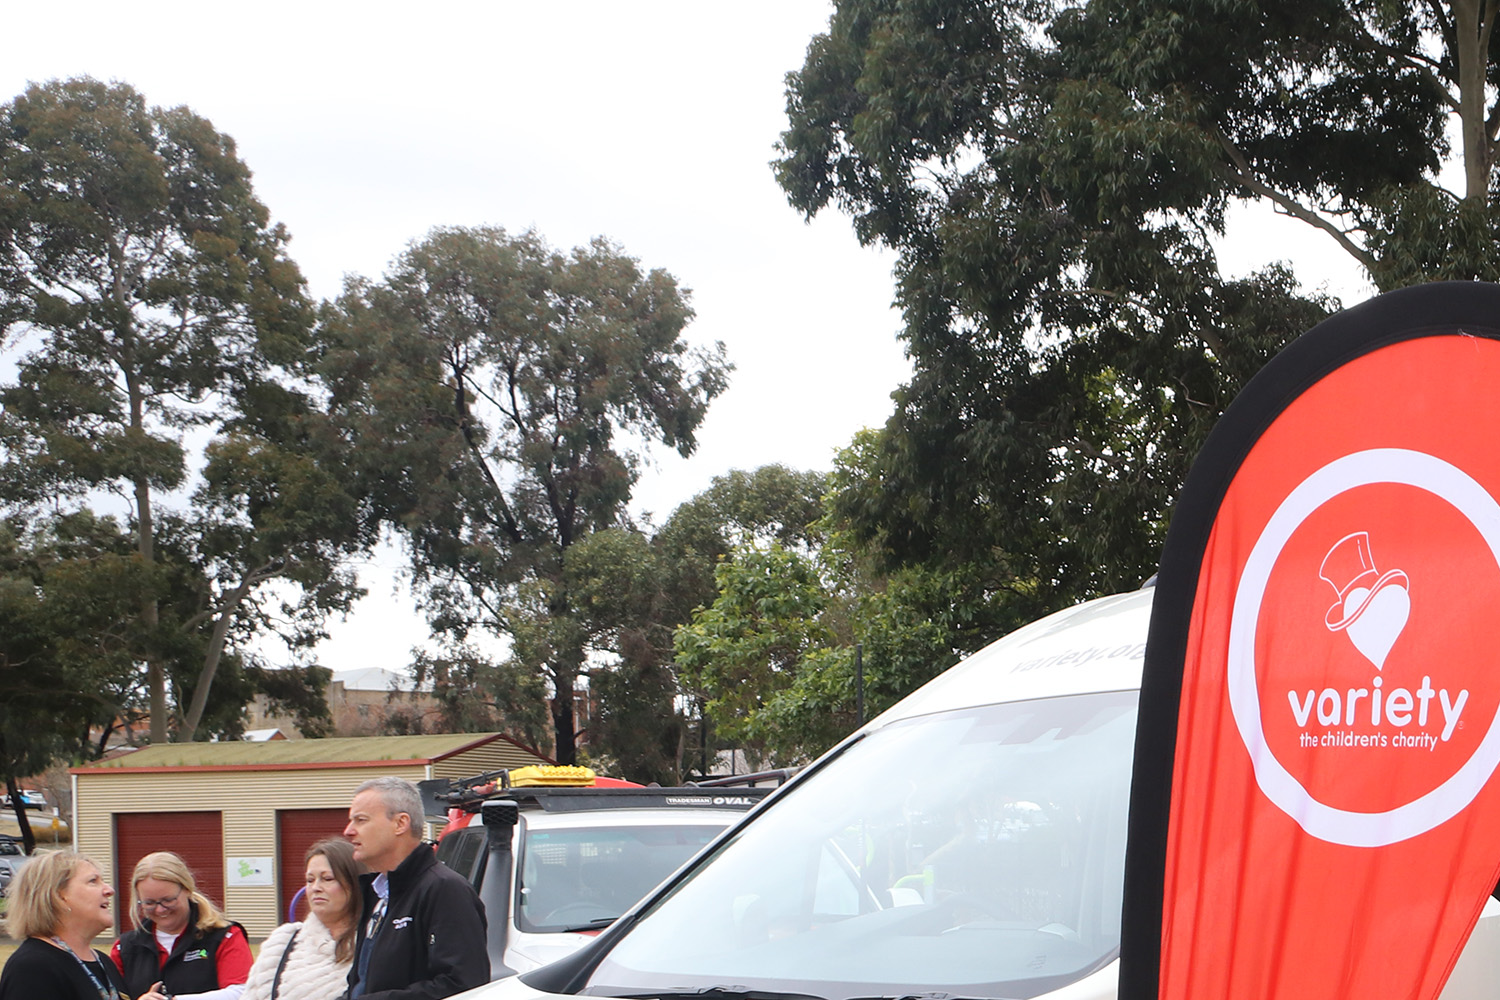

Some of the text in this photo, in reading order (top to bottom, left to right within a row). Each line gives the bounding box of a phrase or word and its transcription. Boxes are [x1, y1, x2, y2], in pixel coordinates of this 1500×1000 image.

[1287, 675, 1469, 742] variety
[1299, 731, 1438, 751] the children's charity
[713, 797, 752, 805] OVAL
